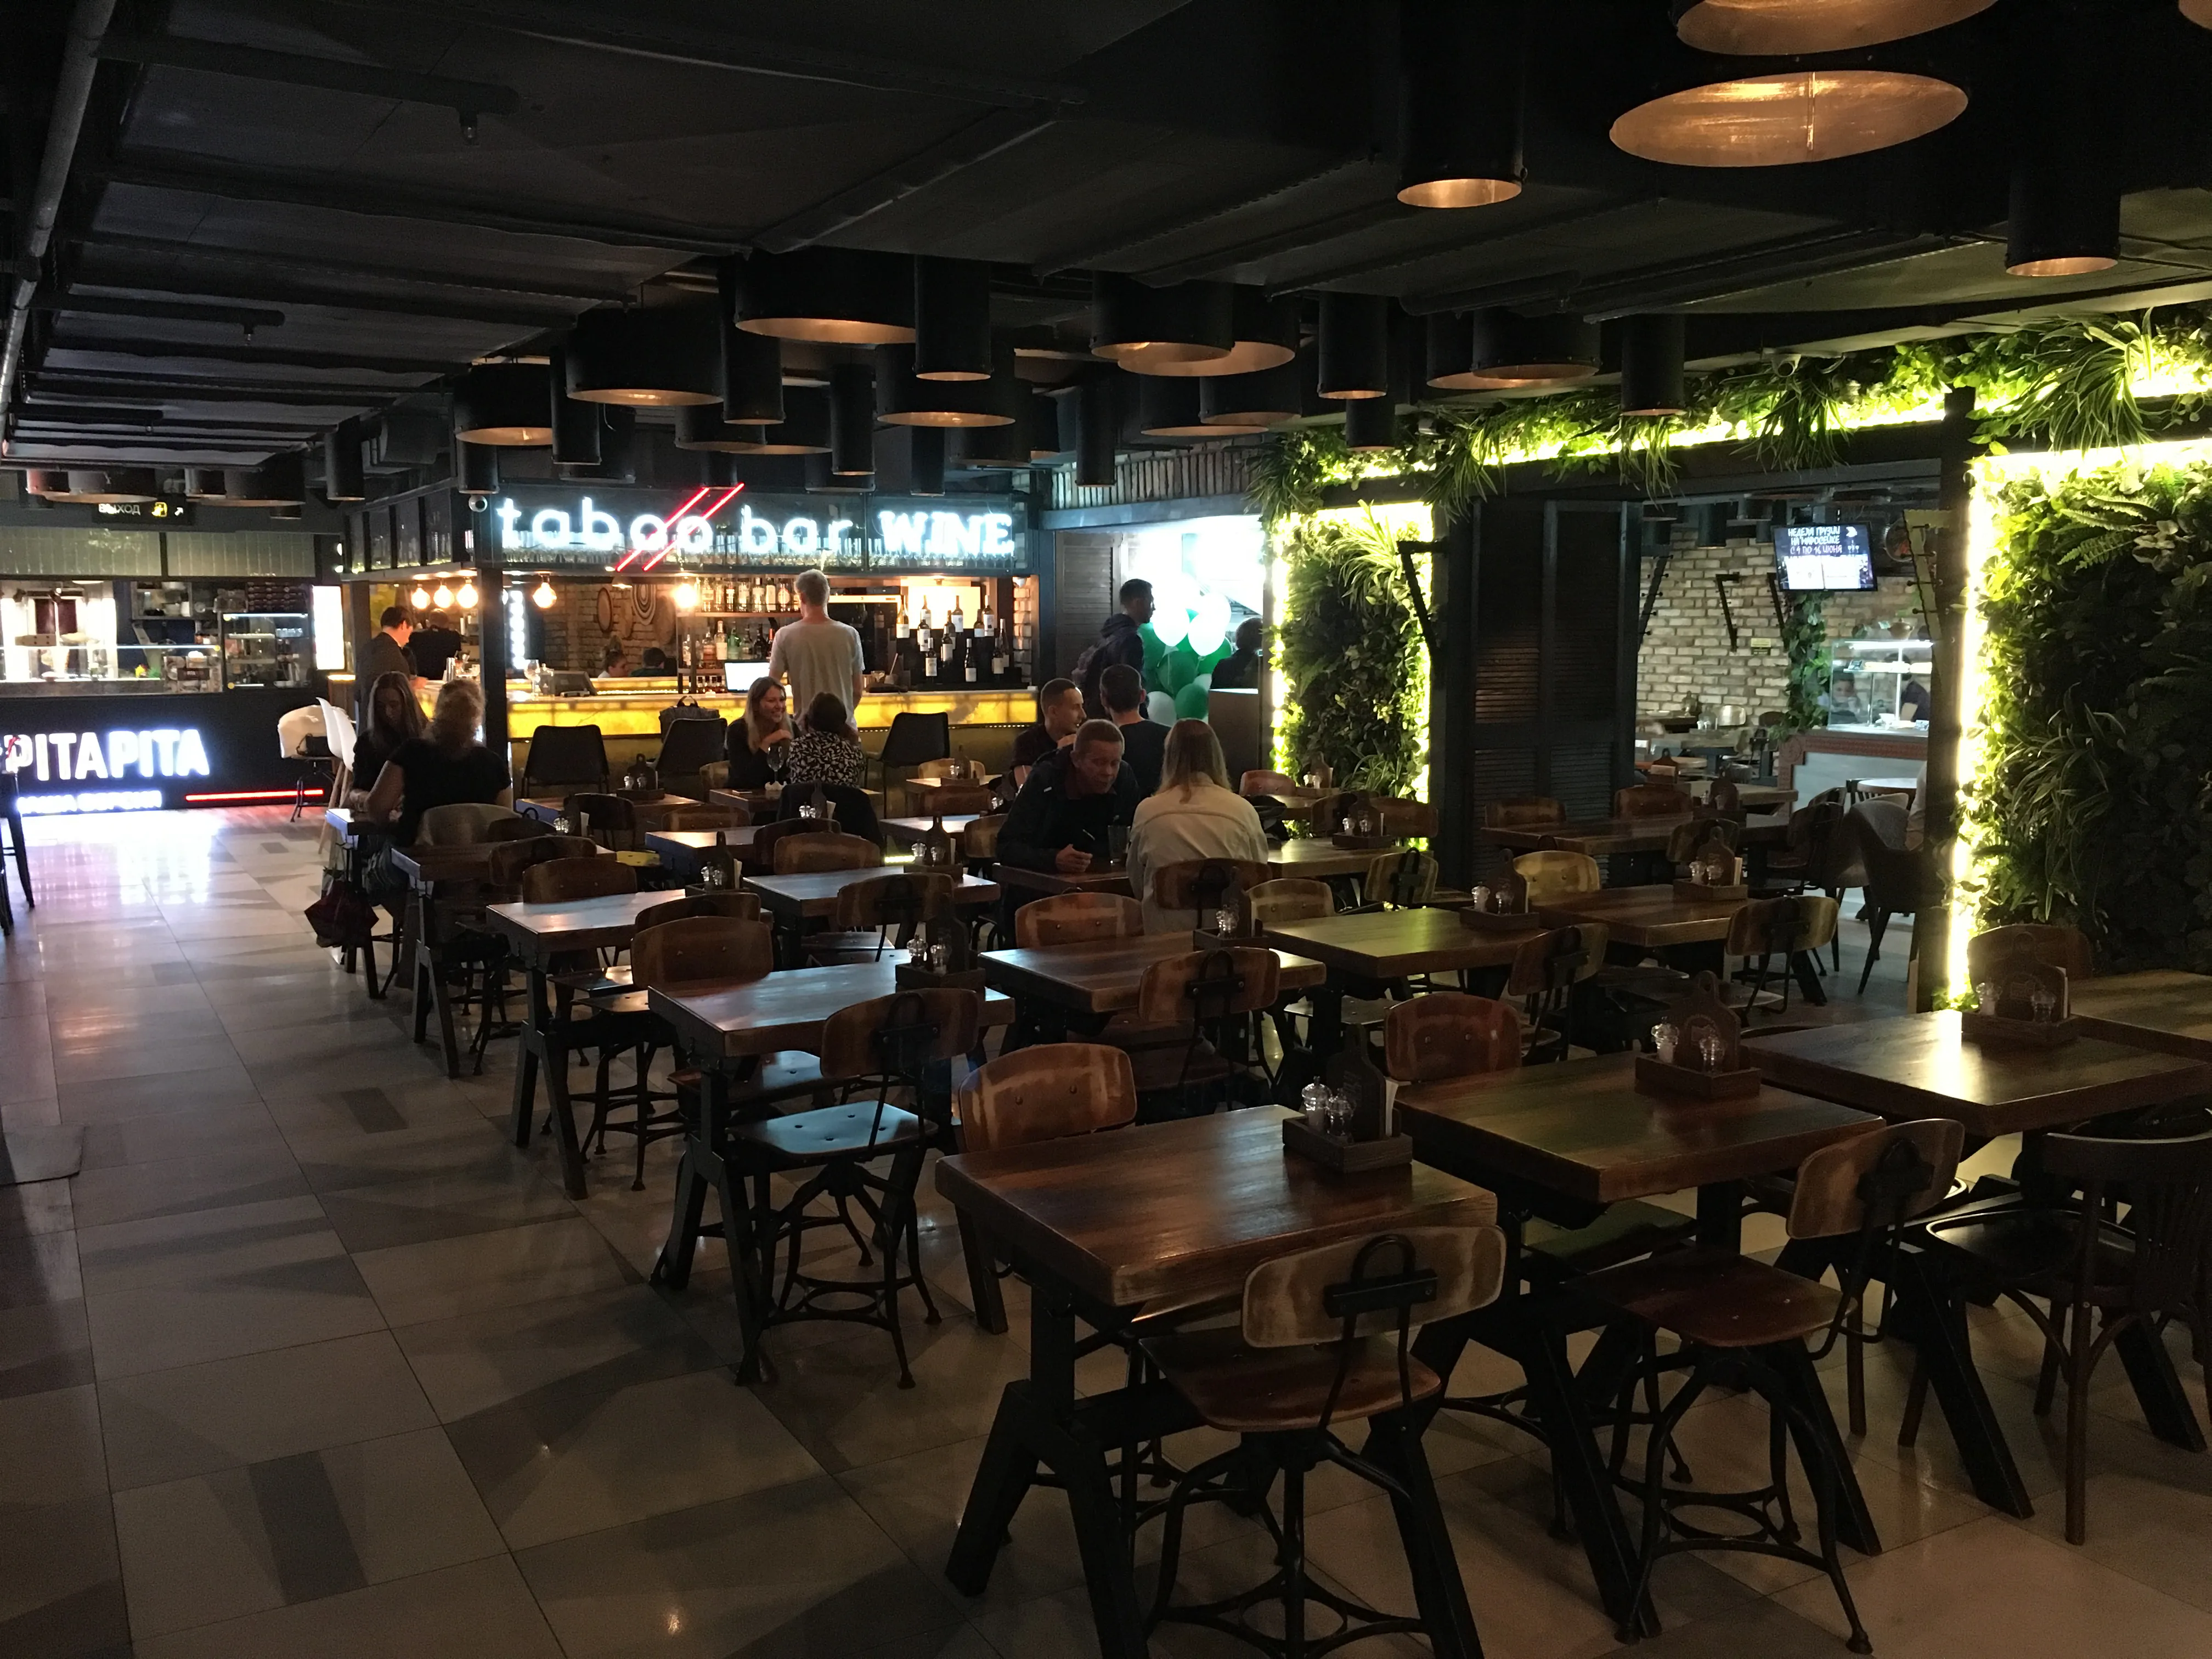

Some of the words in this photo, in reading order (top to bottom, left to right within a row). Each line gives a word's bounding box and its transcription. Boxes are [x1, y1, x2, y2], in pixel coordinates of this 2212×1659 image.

[496, 496, 713, 551] taboo
[741, 504, 853, 554] bar
[878, 511, 1014, 556] WINE
[1788, 527, 1814, 538] НЕДЕЛЯ
[1816, 526, 1840, 536] ГРУЗИИ
[1791, 537, 1800, 546] НА
[1790, 546, 1795, 554] С
[1802, 546, 1812, 554] ПО
[1814, 545, 1821, 554] 16
[1822, 545, 1842, 553] ИЮНЯ
